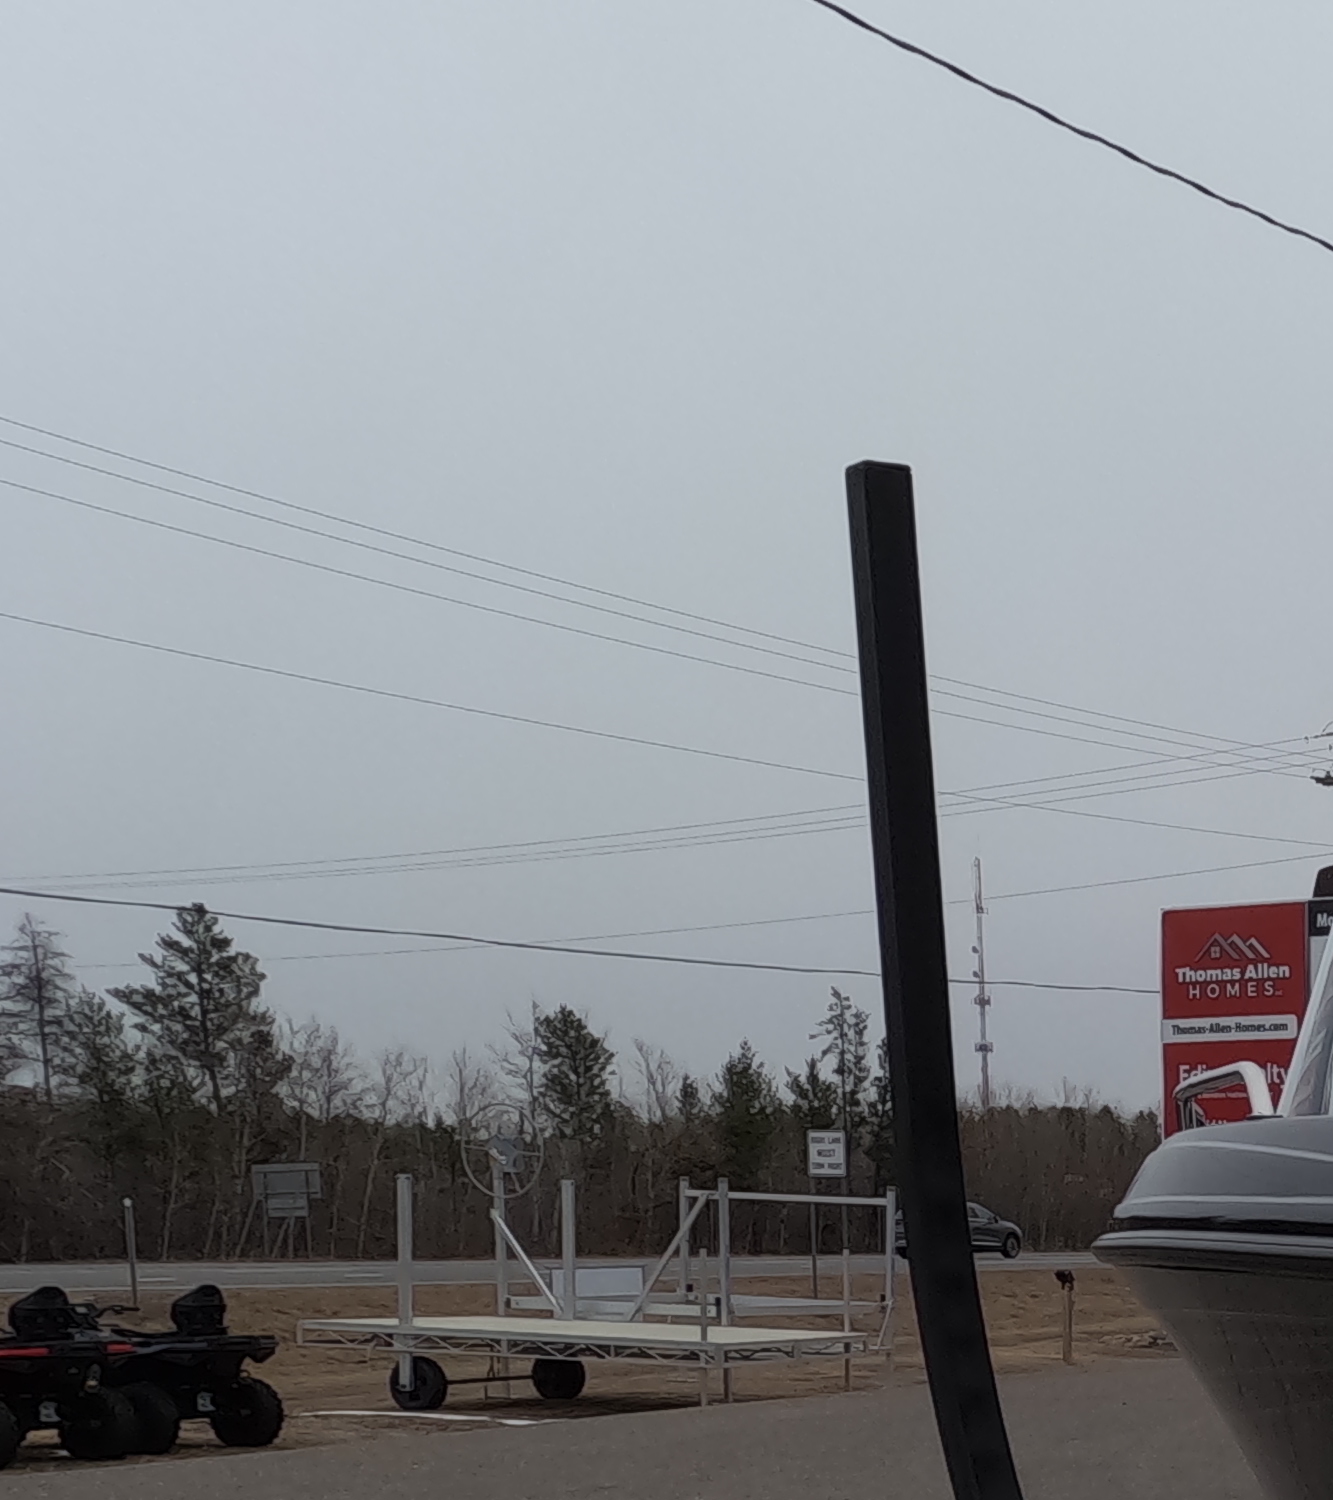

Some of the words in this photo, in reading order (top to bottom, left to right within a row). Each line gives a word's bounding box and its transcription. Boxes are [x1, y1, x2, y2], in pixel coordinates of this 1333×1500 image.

[1175, 966, 1241, 983] Thomas
[1244, 962, 1290, 980] Allen
[1188, 981, 1274, 999] HOMES
